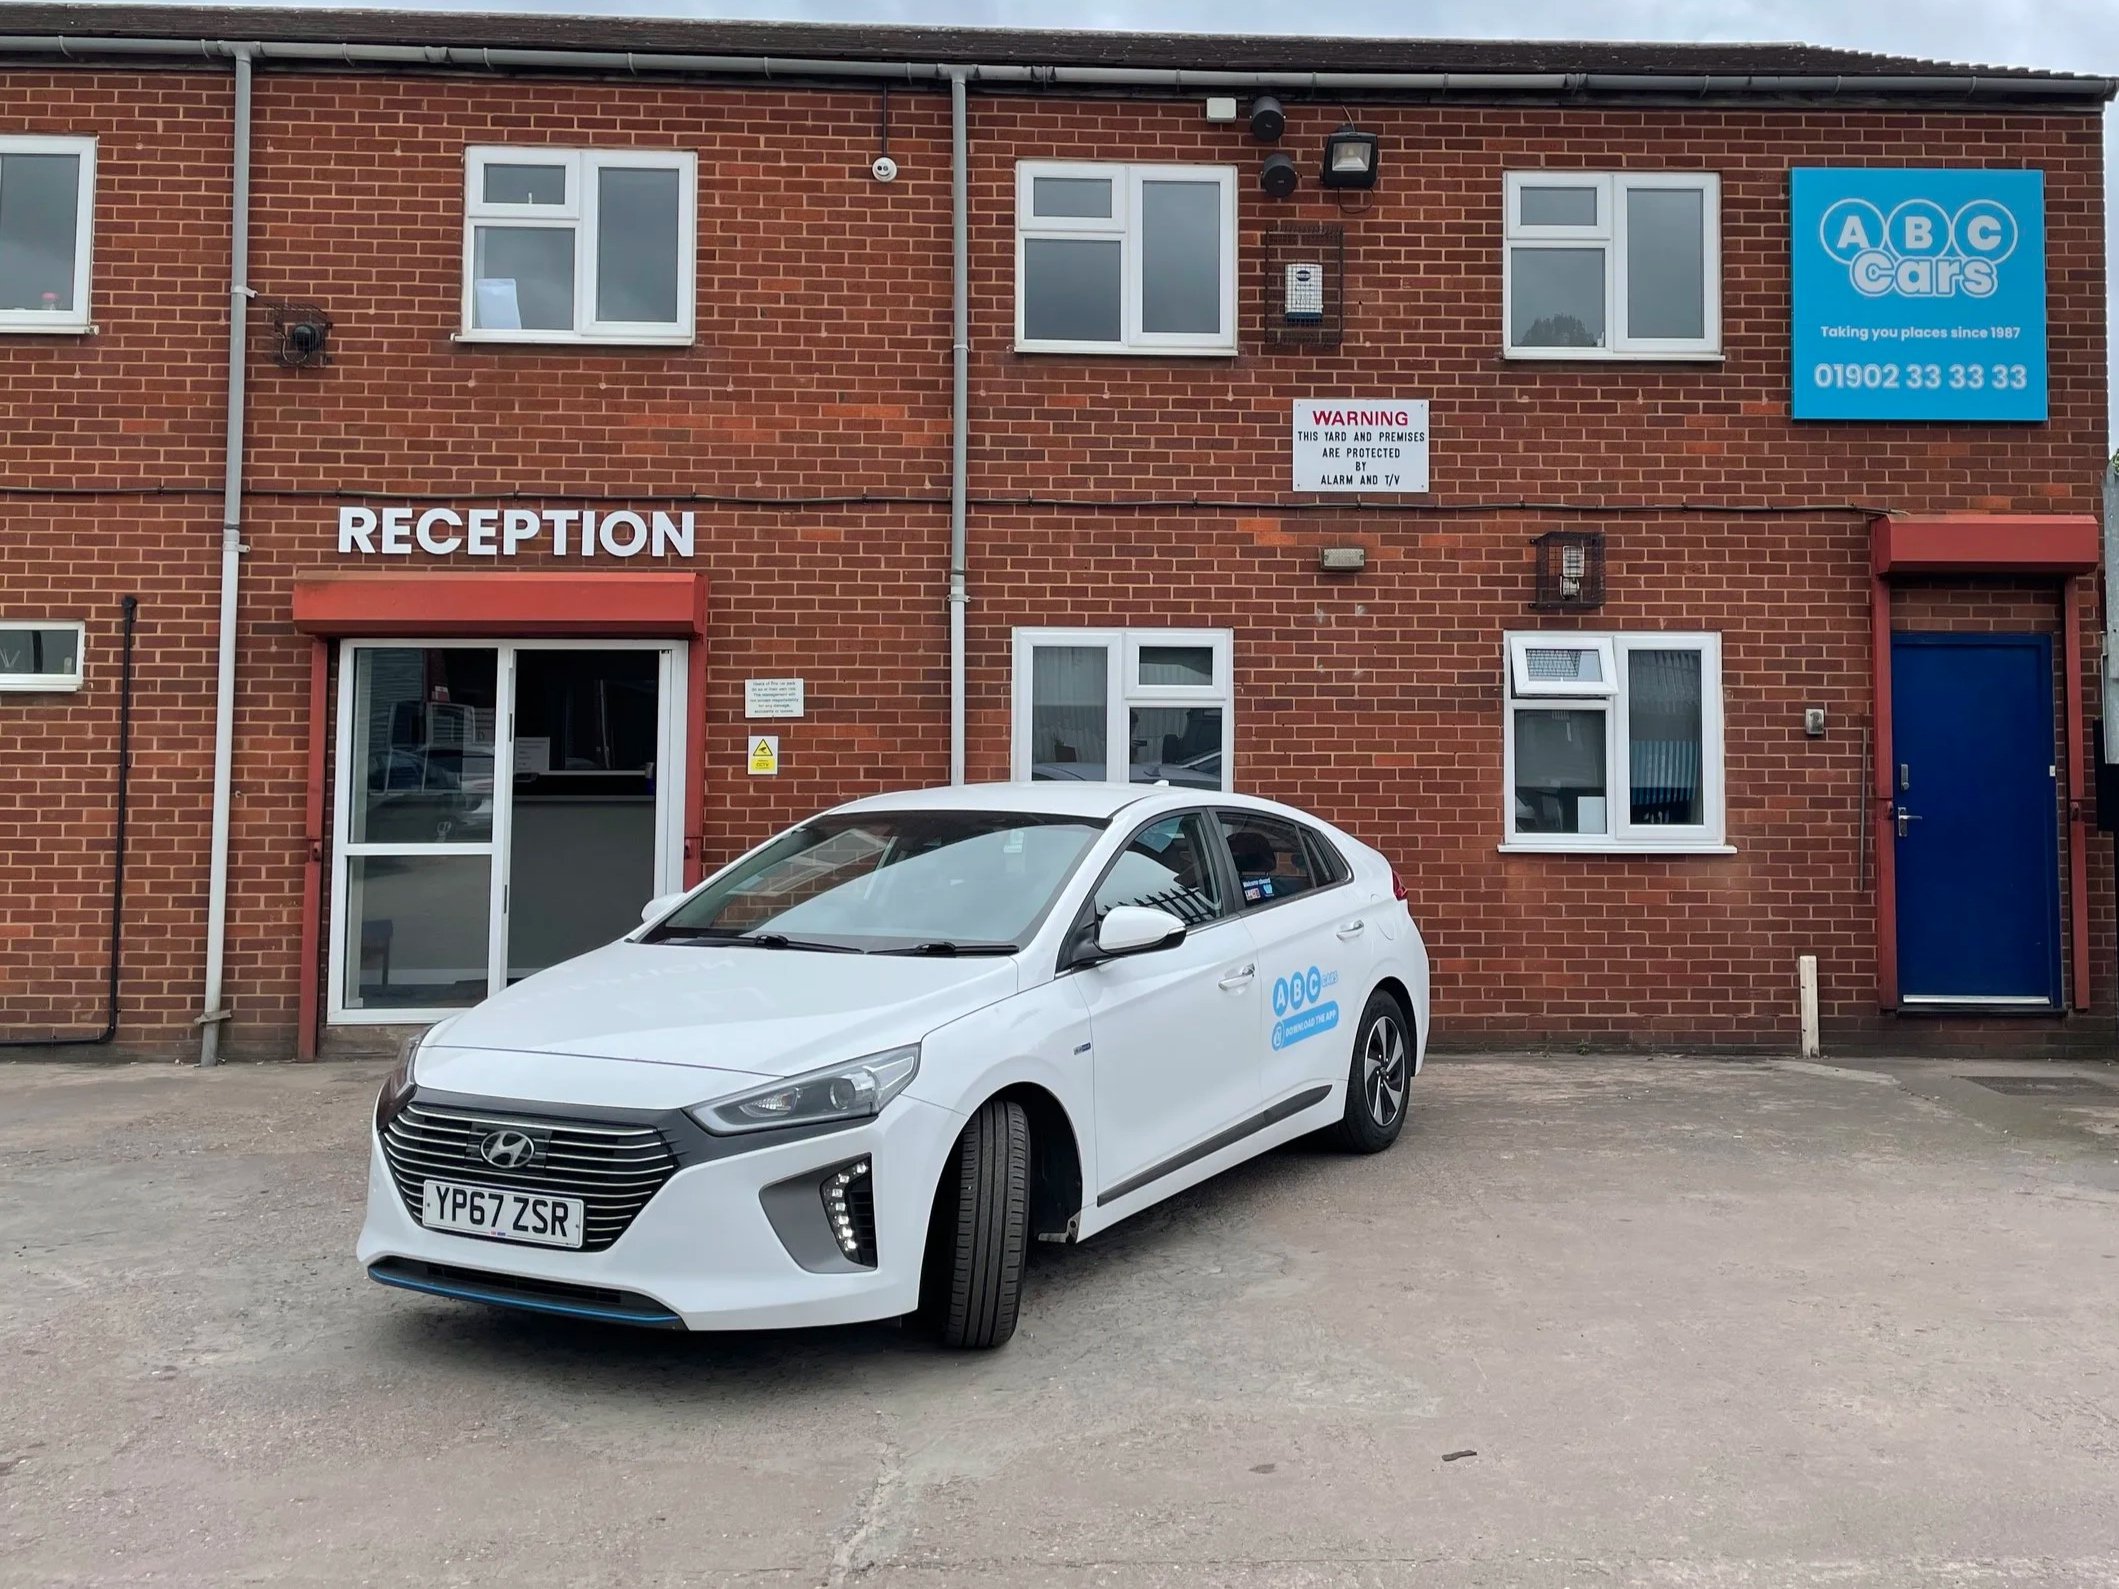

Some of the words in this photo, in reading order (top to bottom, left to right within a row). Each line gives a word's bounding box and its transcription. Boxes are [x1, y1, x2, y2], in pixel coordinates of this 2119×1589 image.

[1852, 250, 1996, 296] Cars
[1820, 325, 1869, 341] Taking
[1871, 328, 1899, 342] you
[1901, 326, 1948, 342] places
[1950, 326, 1989, 339] since
[1990, 327, 2021, 339] 1987
[1814, 363, 1900, 389] 01902
[1905, 364, 1941, 389] 33
[1948, 364, 1985, 389] 33
[1991, 364, 2028, 389] 33
[1312, 410, 1409, 426] WARNING
[1298, 431, 1319, 442] THIS
[1324, 431, 1347, 442] YARD
[1353, 431, 1372, 442] AND
[1379, 431, 1425, 442] PREMISES
[1322, 447, 1340, 458] ARE
[1346, 447, 1401, 458] PROTECTED
[1355, 461, 1367, 472] BY
[1320, 474, 1353, 485] ALARM
[1359, 474, 1378, 485] AND
[1384, 474, 1400, 487] T/V
[338, 506, 695, 557] RECEPTION
[1286, 1017, 1315, 1037] DOWNLOAD
[1325, 1009, 1337, 1021] APP
[435, 1185, 505, 1228] YP67
[512, 1196, 569, 1238] ZSR
